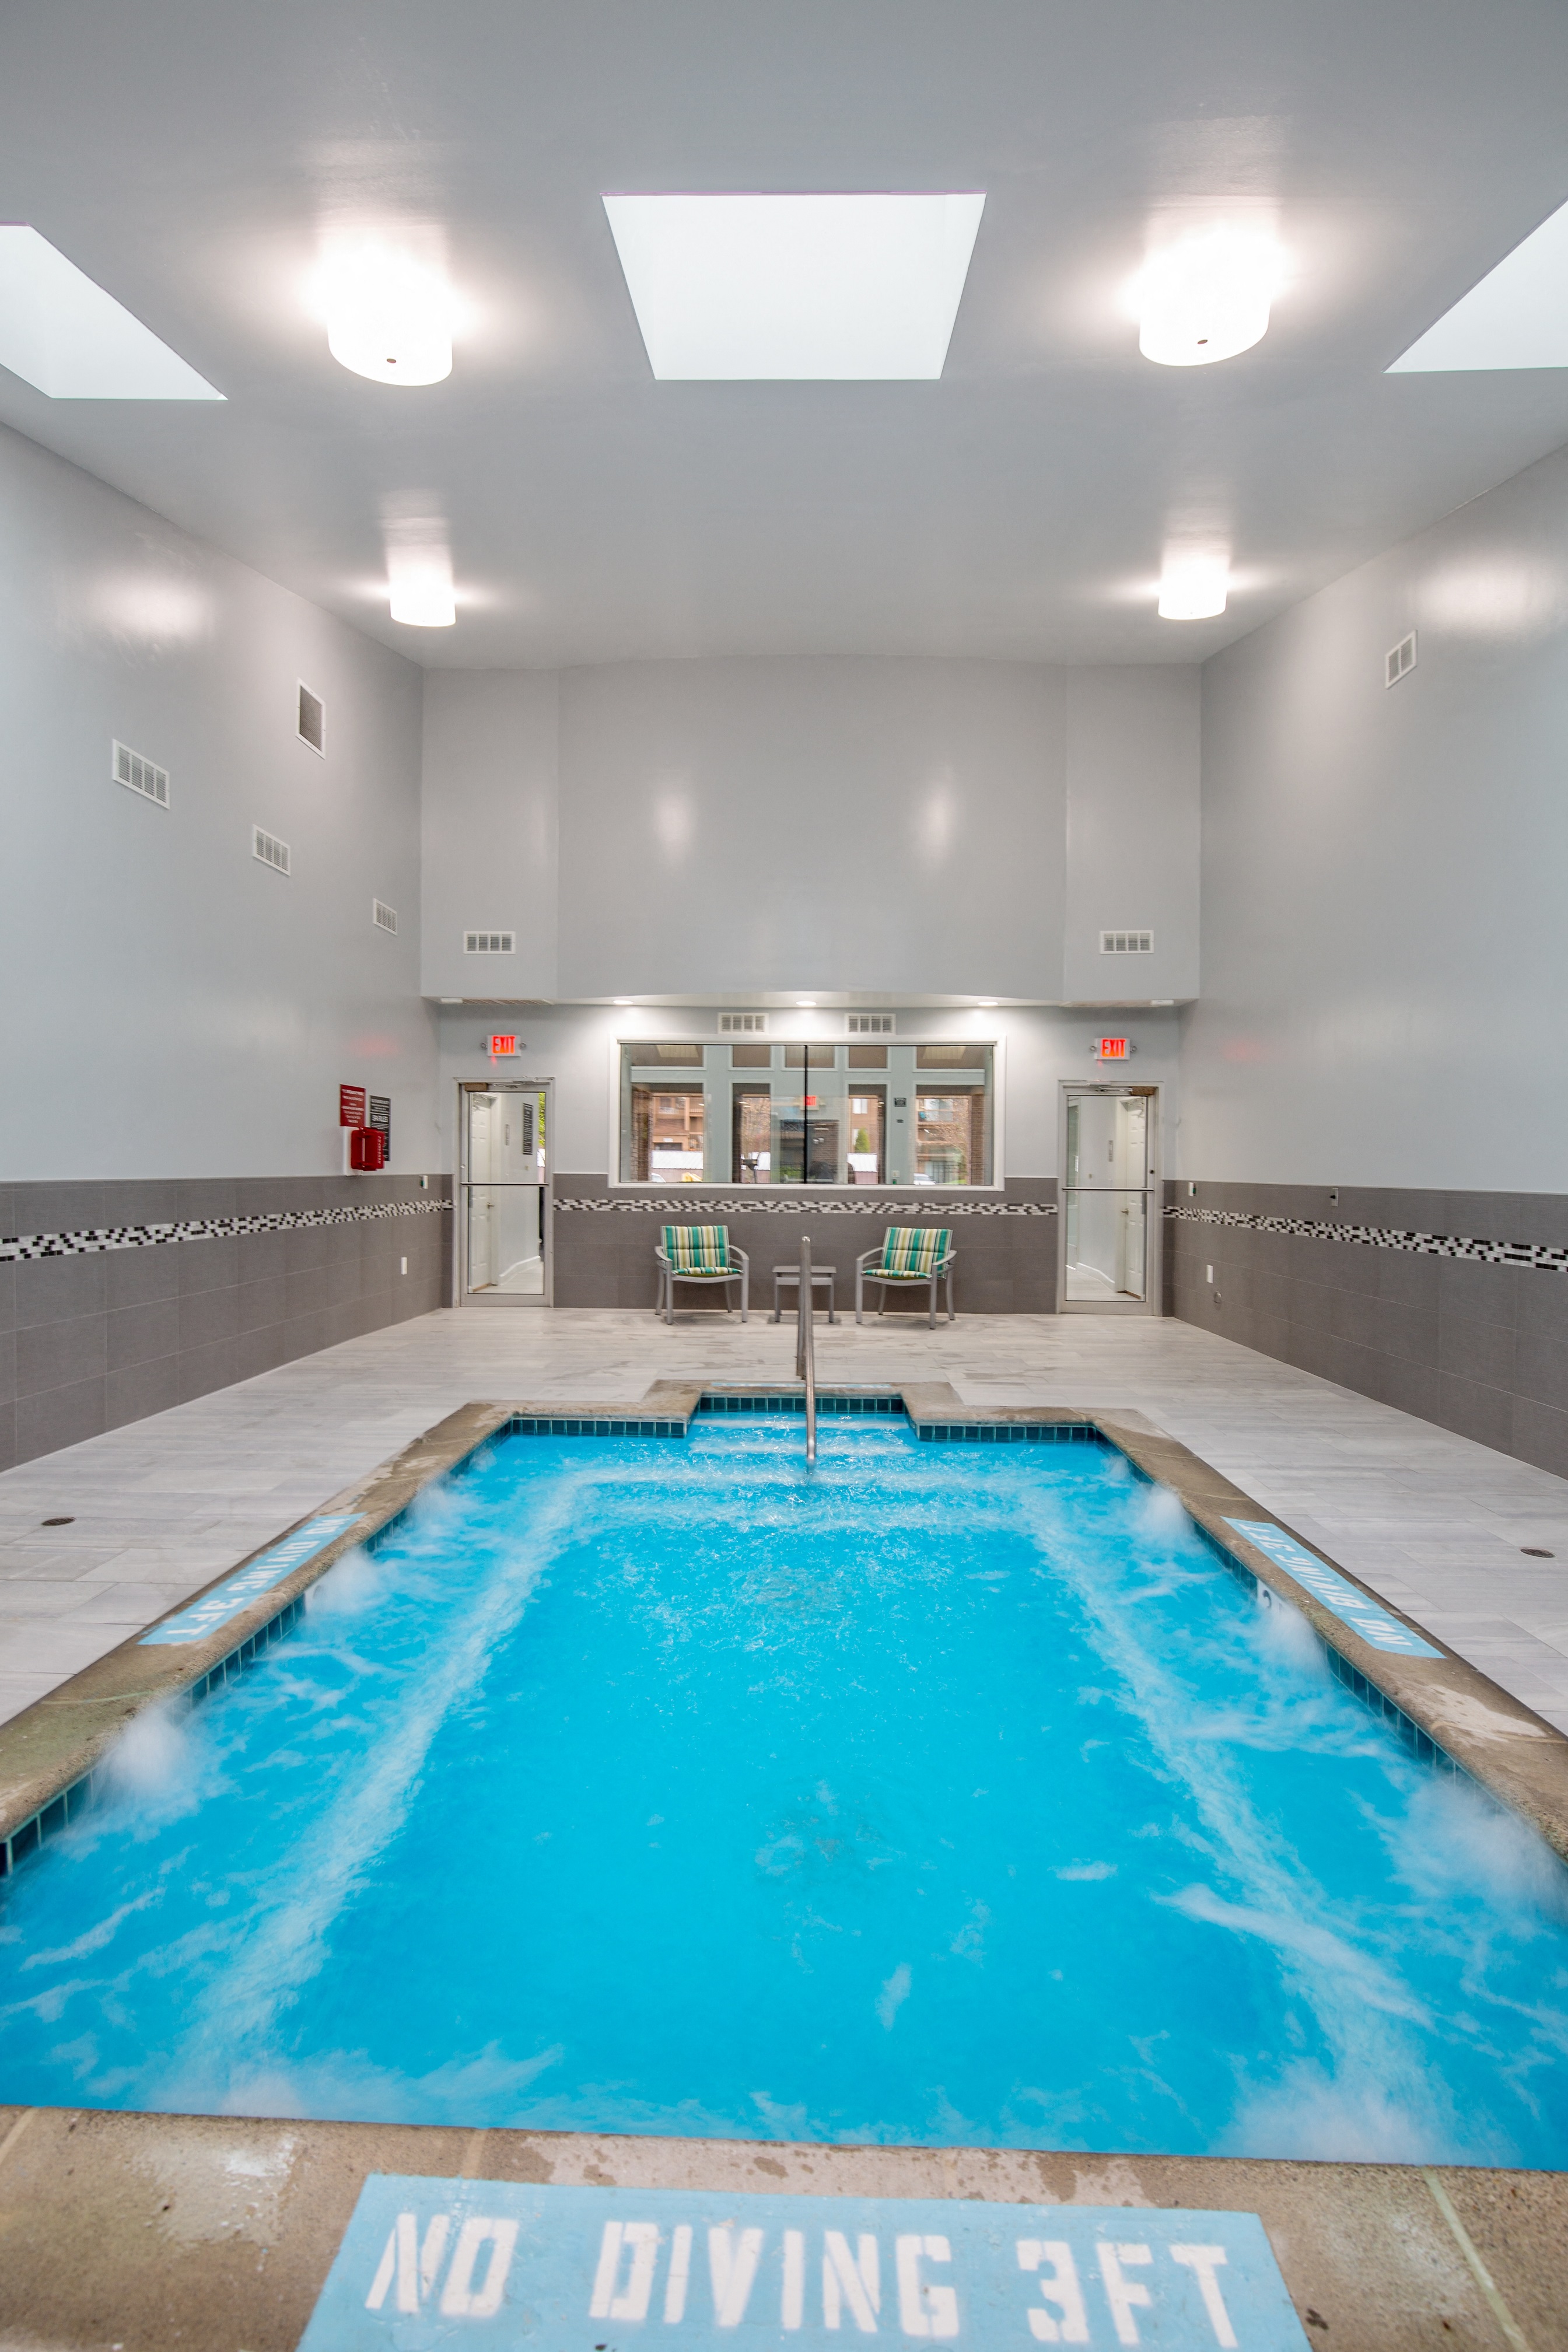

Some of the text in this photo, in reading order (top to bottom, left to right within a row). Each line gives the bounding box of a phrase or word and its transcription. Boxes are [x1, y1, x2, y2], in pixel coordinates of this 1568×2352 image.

[492, 1035, 516, 1054] EXIT
[1101, 1038, 1126, 1058] EXIT
[1238, 1523, 1296, 1553] 3FT
[166, 1518, 351, 1636] NO DIVING 3FT
[1275, 1553, 1368, 1610] DIVING
[1350, 1617, 1414, 1647] NO
[365, 2212, 1239, 2349] NO DIVING 3FT
